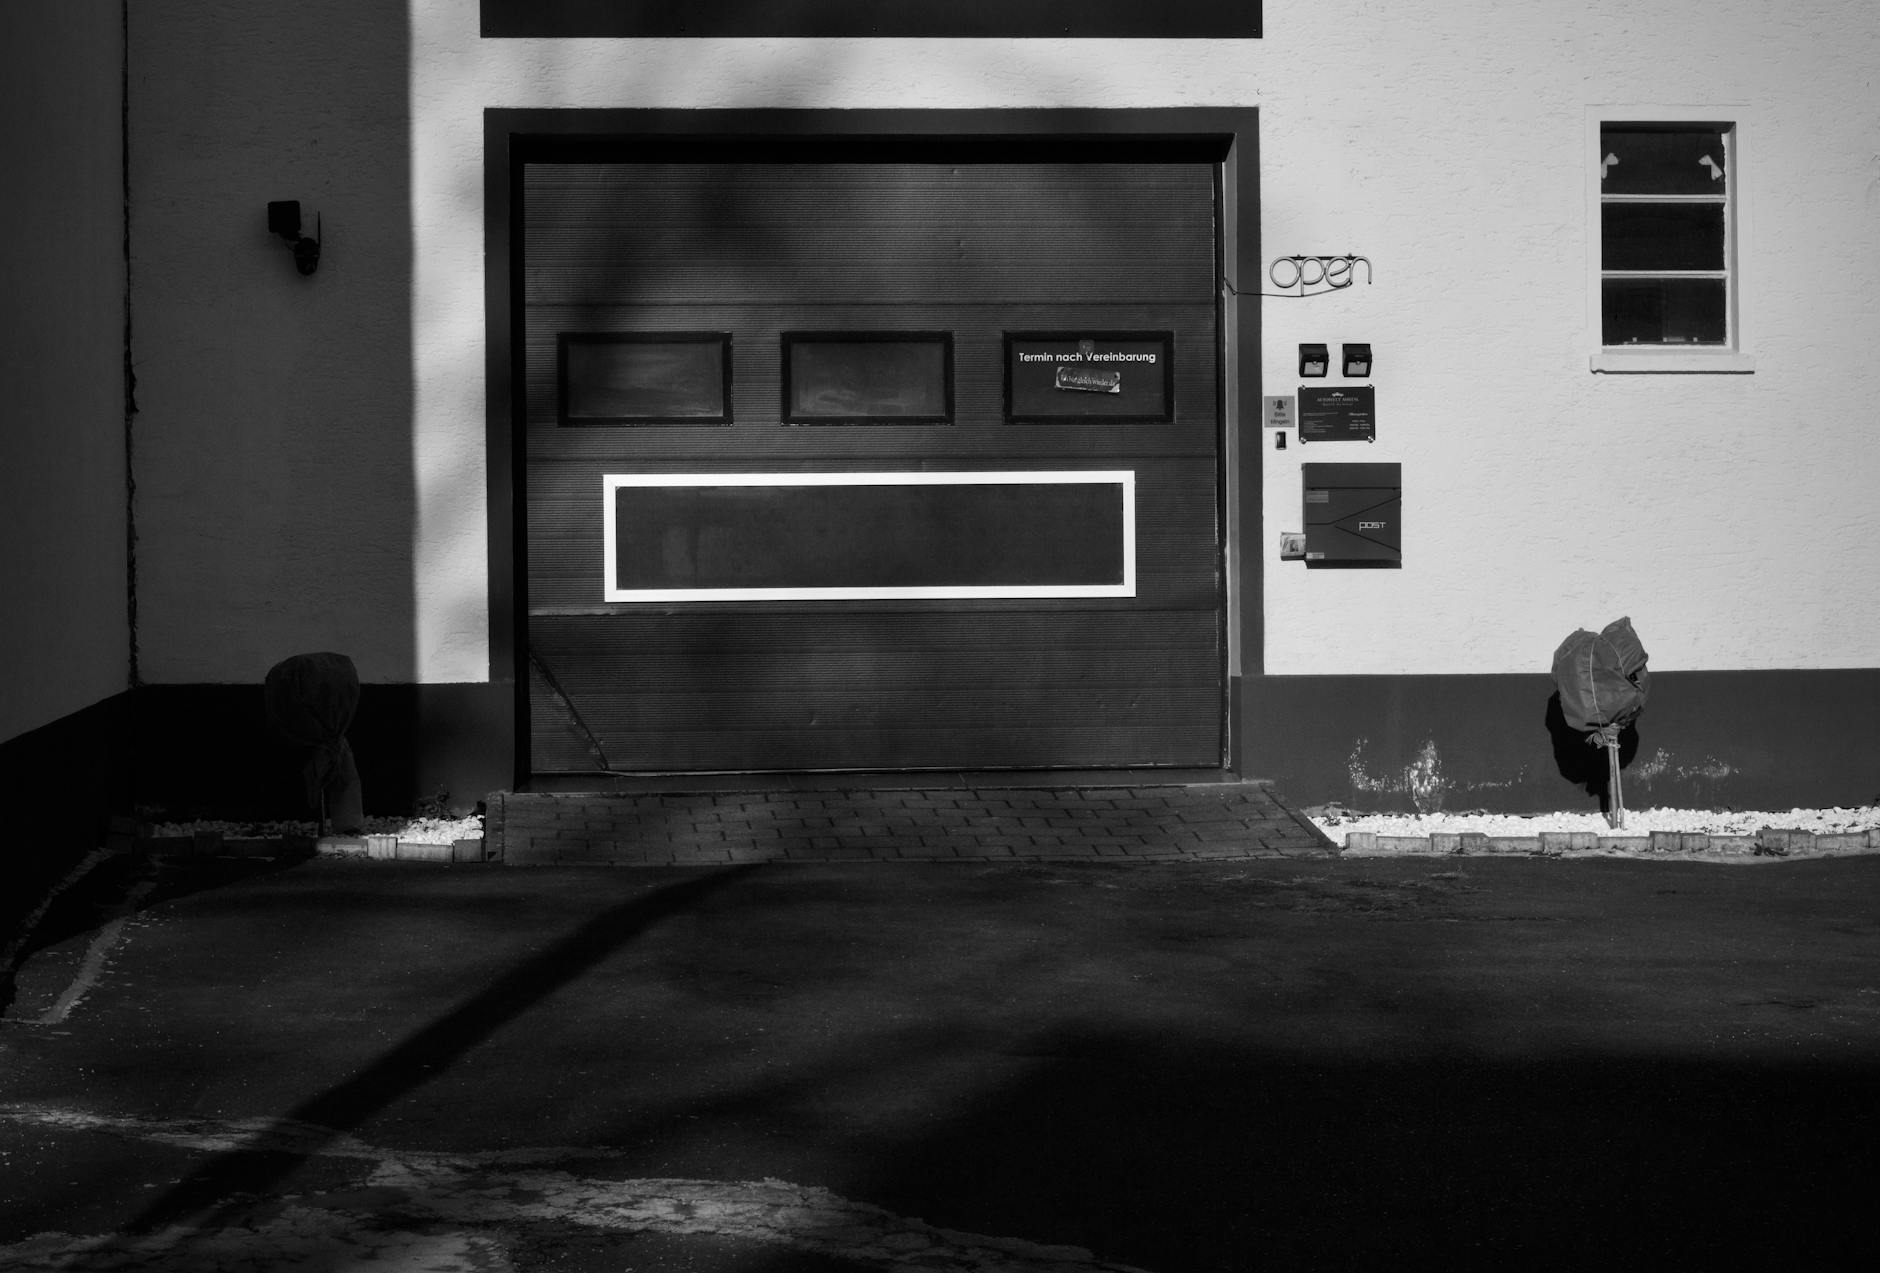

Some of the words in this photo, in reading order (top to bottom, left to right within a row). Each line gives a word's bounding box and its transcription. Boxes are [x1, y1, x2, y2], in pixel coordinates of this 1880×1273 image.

[1269, 256, 1372, 297] open
[1019, 352, 1053, 362] Termin
[1056, 352, 1083, 362] nach
[1086, 351, 1156, 364] Vereinbarung
